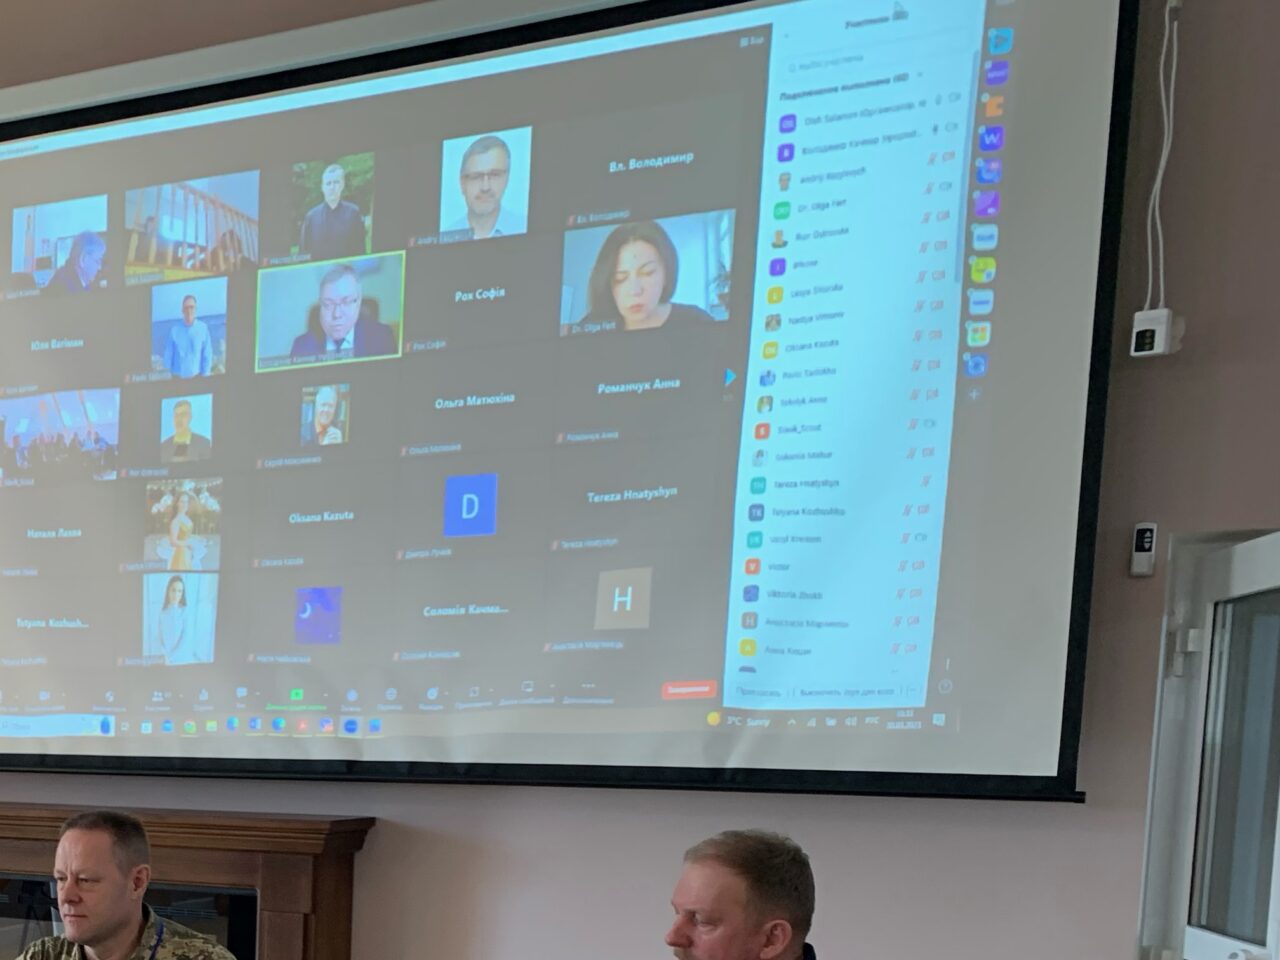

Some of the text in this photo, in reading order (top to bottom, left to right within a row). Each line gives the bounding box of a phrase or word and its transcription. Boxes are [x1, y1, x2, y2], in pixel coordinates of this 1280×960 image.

[609, 152, 695, 173] Вл. Володимир
[475, 285, 506, 301] Софія
[598, 377, 681, 395] Романчук Анна
[435, 398, 464, 410] Ольга
[587, 485, 678, 504] Tereza Hnatyshyn
[461, 494, 479, 519] D
[289, 510, 354, 524] Oksana Kazuta
